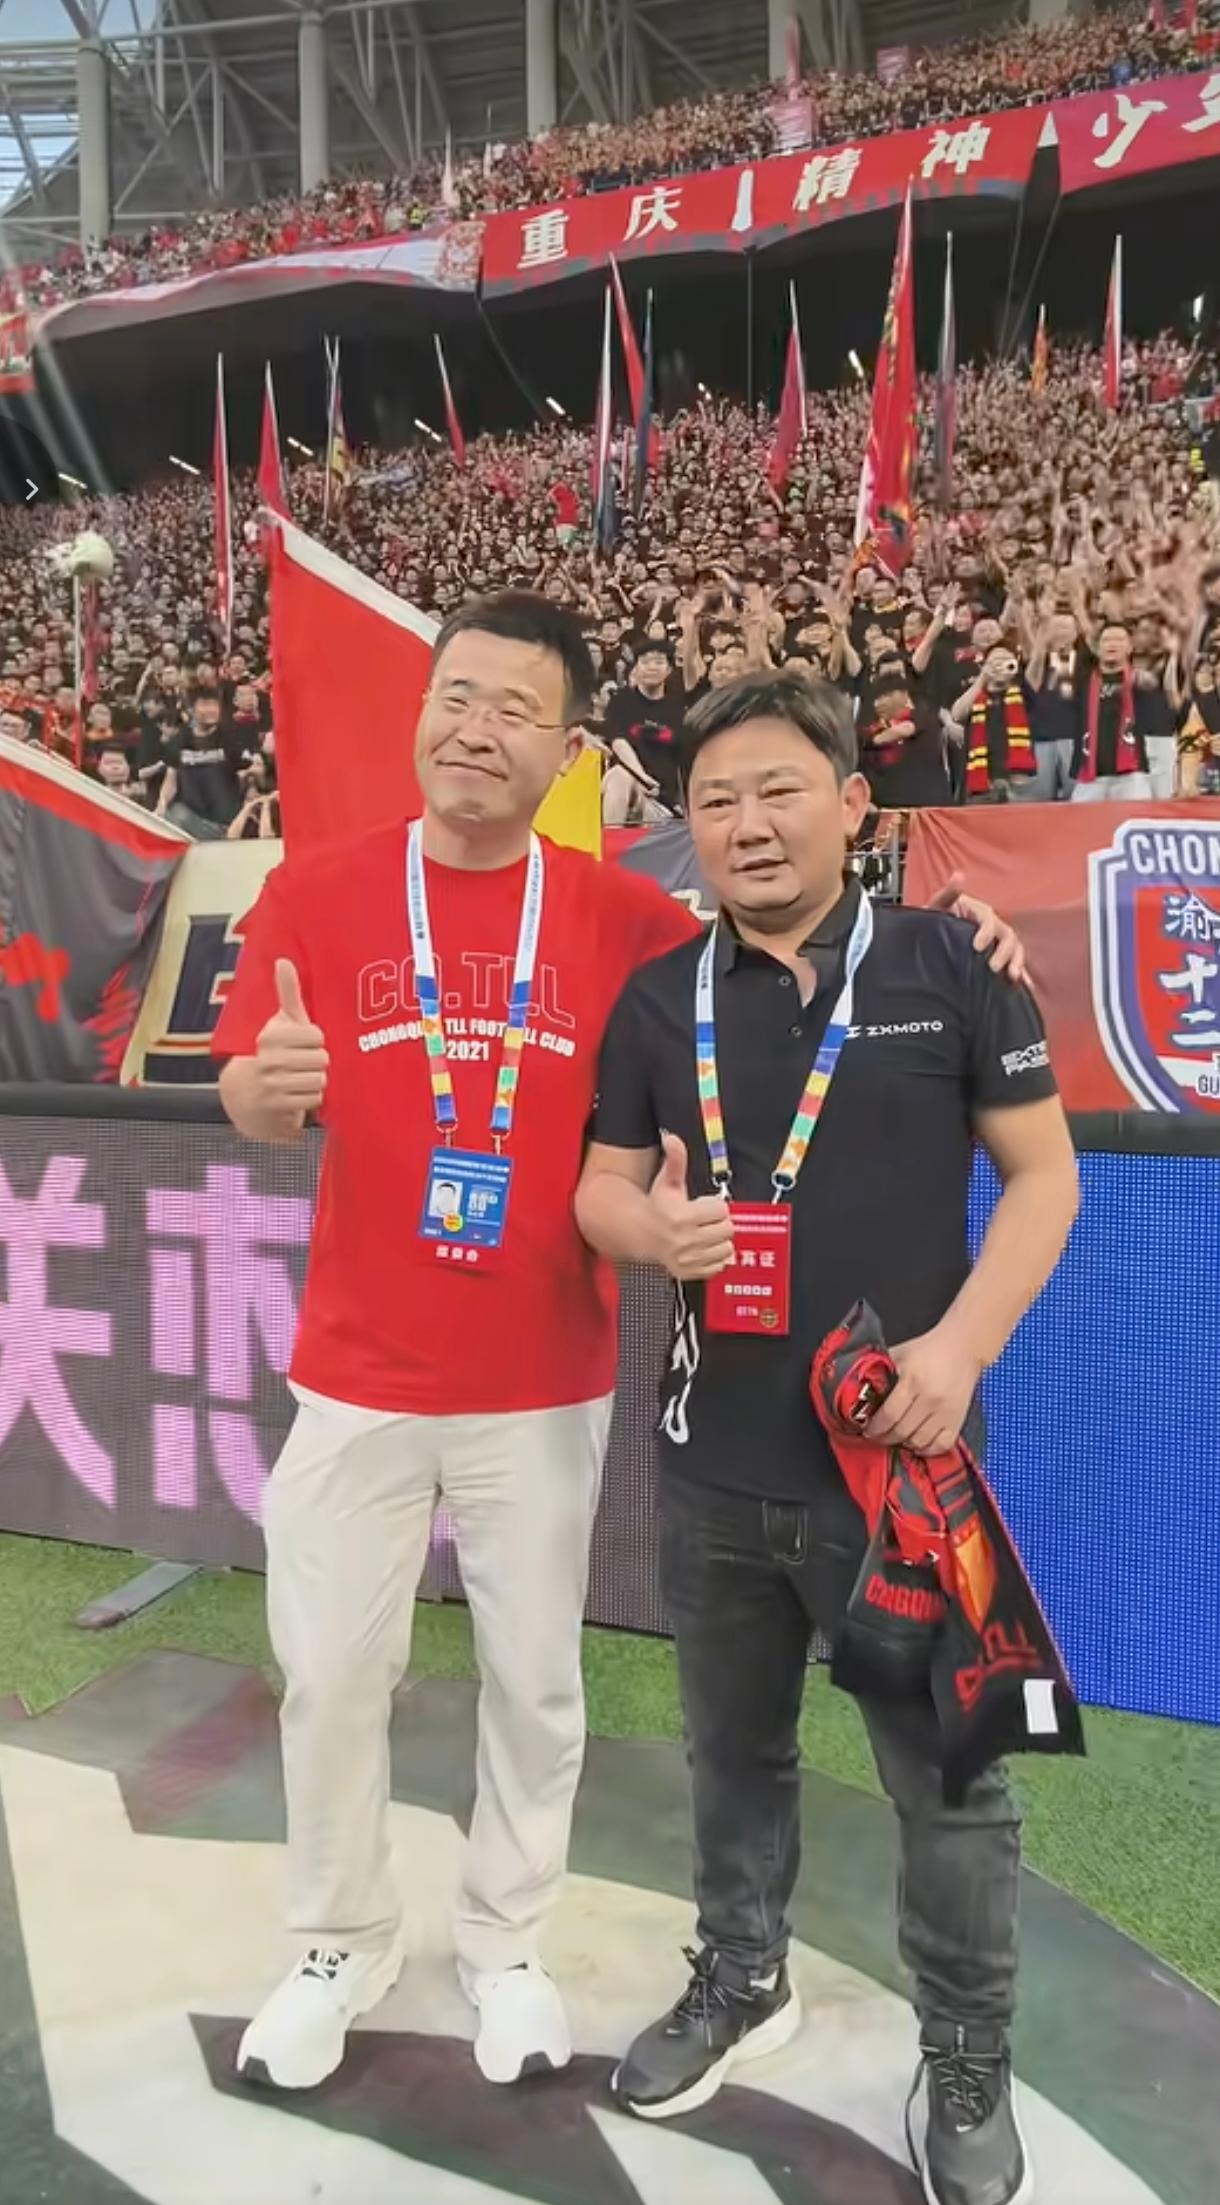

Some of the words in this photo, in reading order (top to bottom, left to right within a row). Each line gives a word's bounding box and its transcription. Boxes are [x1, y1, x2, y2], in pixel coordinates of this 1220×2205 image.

[517, 187, 682, 269] 重庆
[792, 120, 991, 211] 精神
[866, 1019, 944, 1037] ZXMOTO
[447, 1039, 490, 1061] 2021
